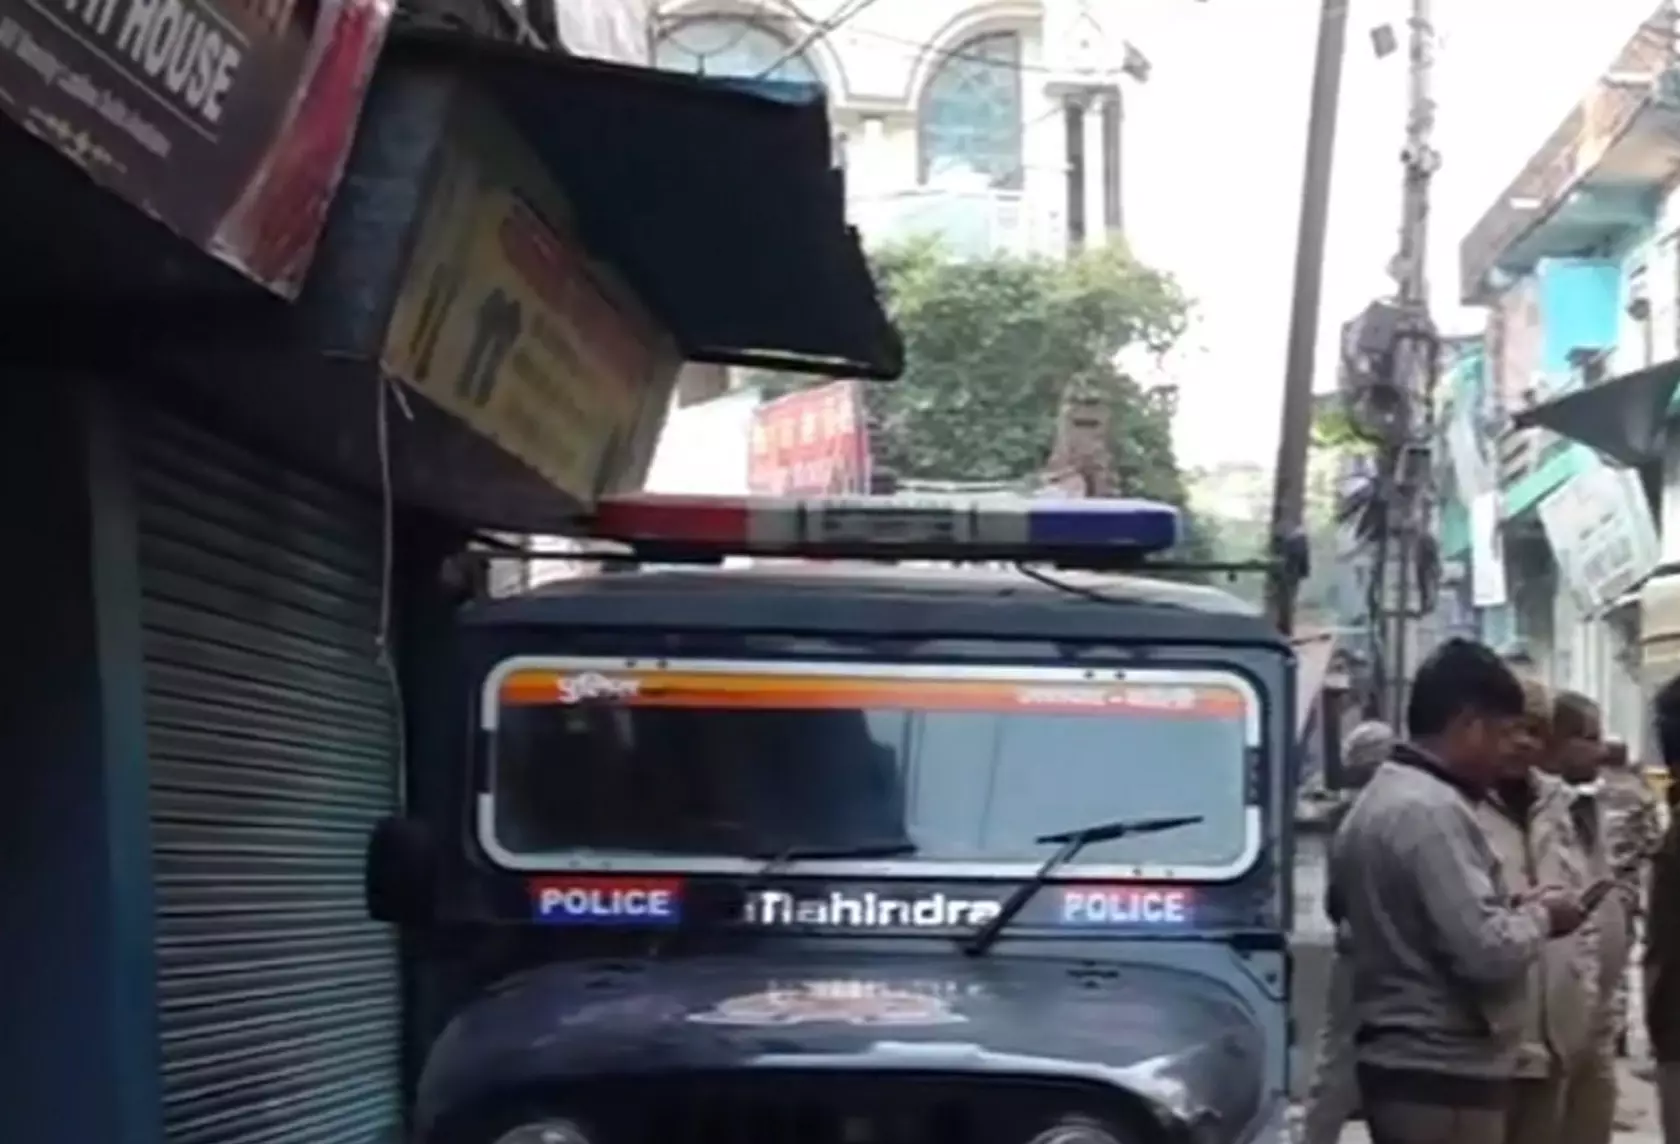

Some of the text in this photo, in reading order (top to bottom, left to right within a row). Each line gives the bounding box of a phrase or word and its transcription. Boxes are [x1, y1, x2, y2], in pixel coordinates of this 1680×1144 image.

[115, 0, 242, 122] HOUSE
[540, 888, 672, 916] POLICE
[1063, 891, 1186, 923] POLICE
